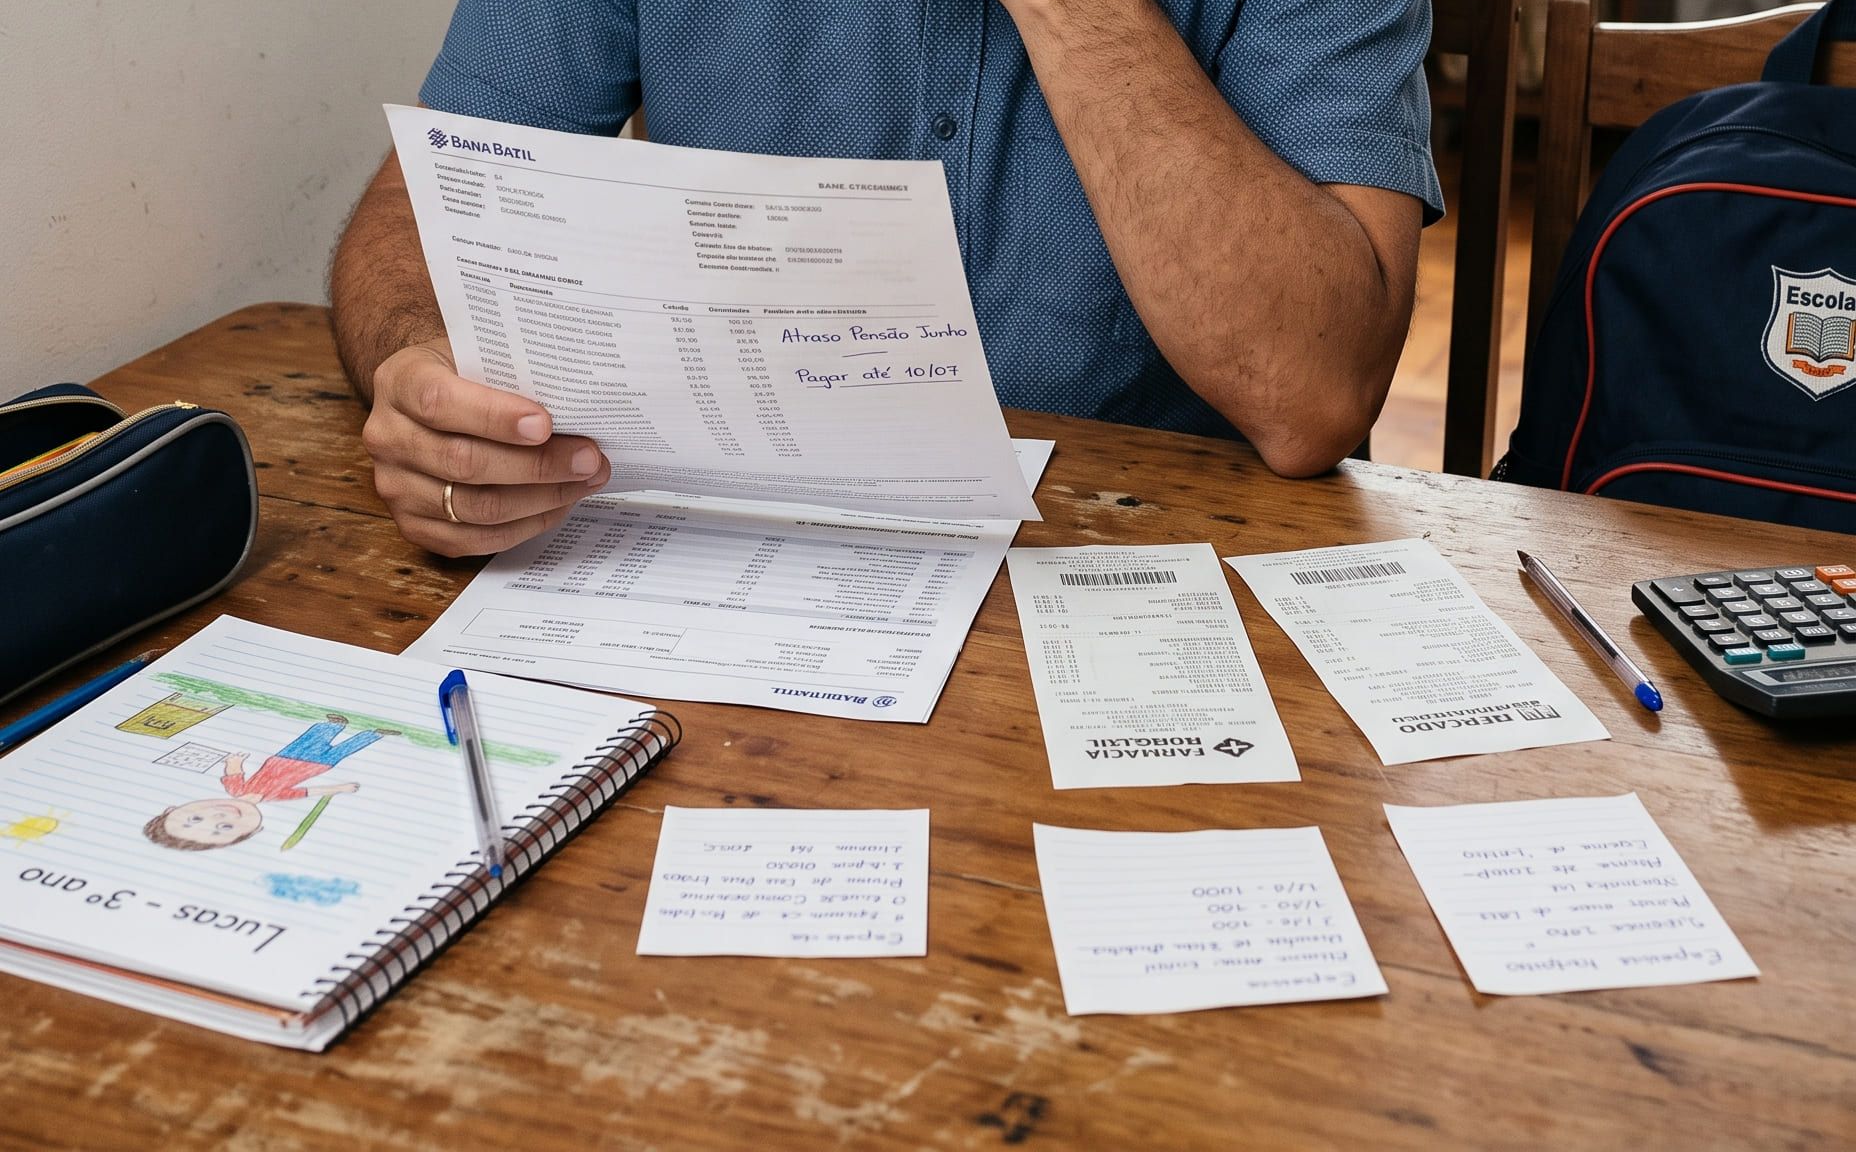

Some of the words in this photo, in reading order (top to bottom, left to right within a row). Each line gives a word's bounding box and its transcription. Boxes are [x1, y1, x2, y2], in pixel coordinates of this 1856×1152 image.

[1786, 286, 1856, 311] Escola
[781, 328, 841, 344] Atraso
[849, 326, 909, 340] Pensão
[919, 323, 968, 339] Junho
[795, 367, 849, 389] Pagar
[862, 366, 892, 380] até
[904, 364, 959, 379] 10/07
[1085, 747, 1205, 759] FARMACIA
[19, 866, 87, 894] ano
[172, 904, 288, 953] Lucas
